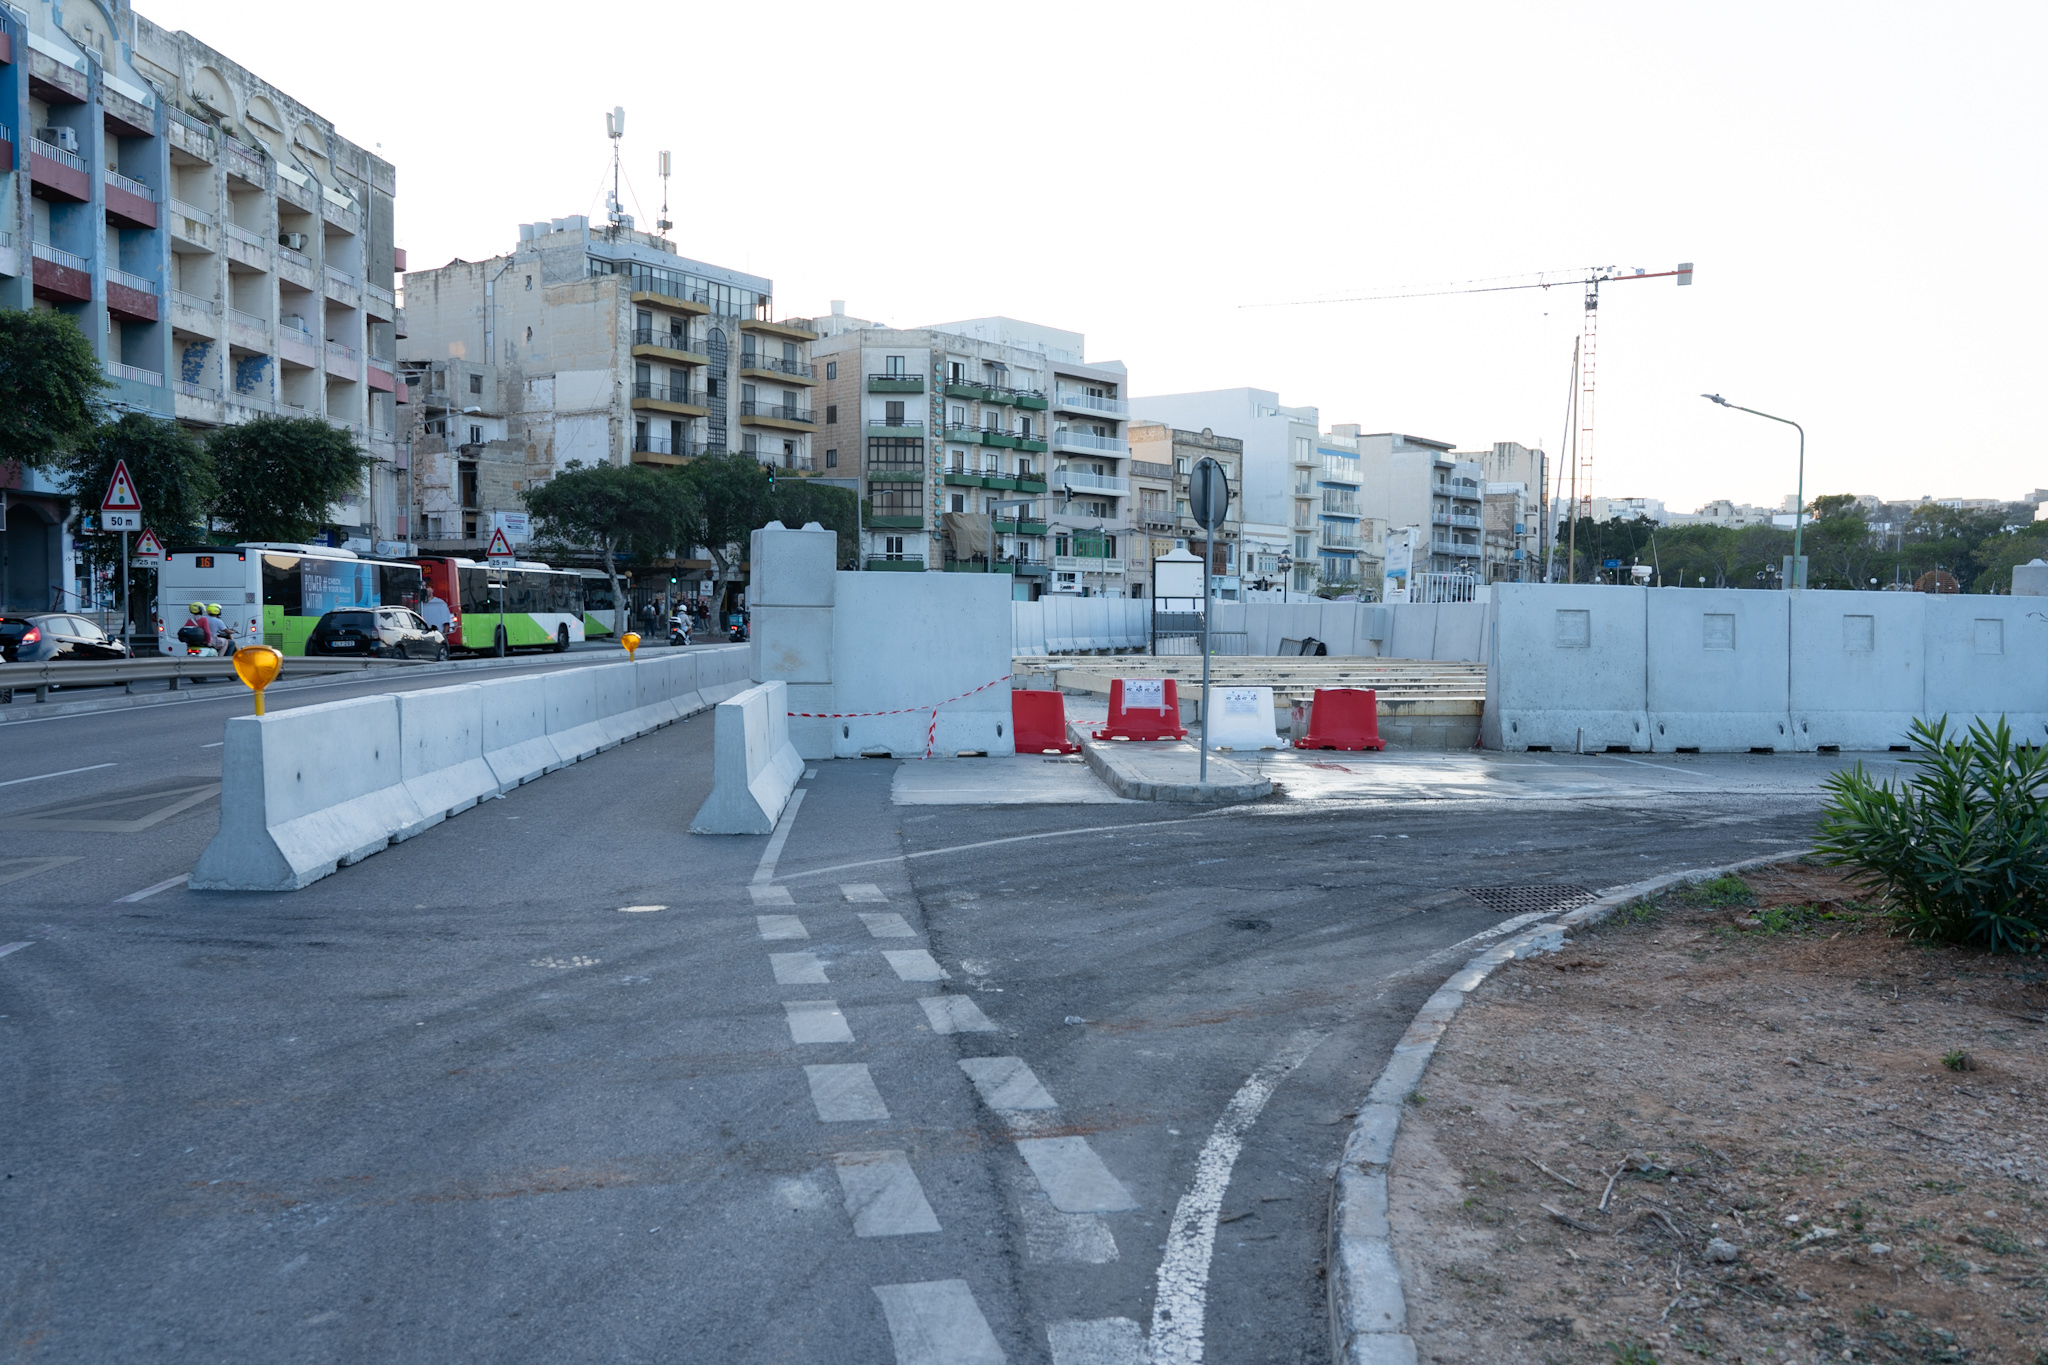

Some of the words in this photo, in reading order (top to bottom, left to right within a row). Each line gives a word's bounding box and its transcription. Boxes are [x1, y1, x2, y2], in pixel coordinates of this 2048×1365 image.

[111, 516, 123, 526] 50
[126, 518, 133, 526] m
[200, 557, 211, 568] 16
[304, 574, 323, 592] POWER
[327, 577, 342, 585] CHECK
